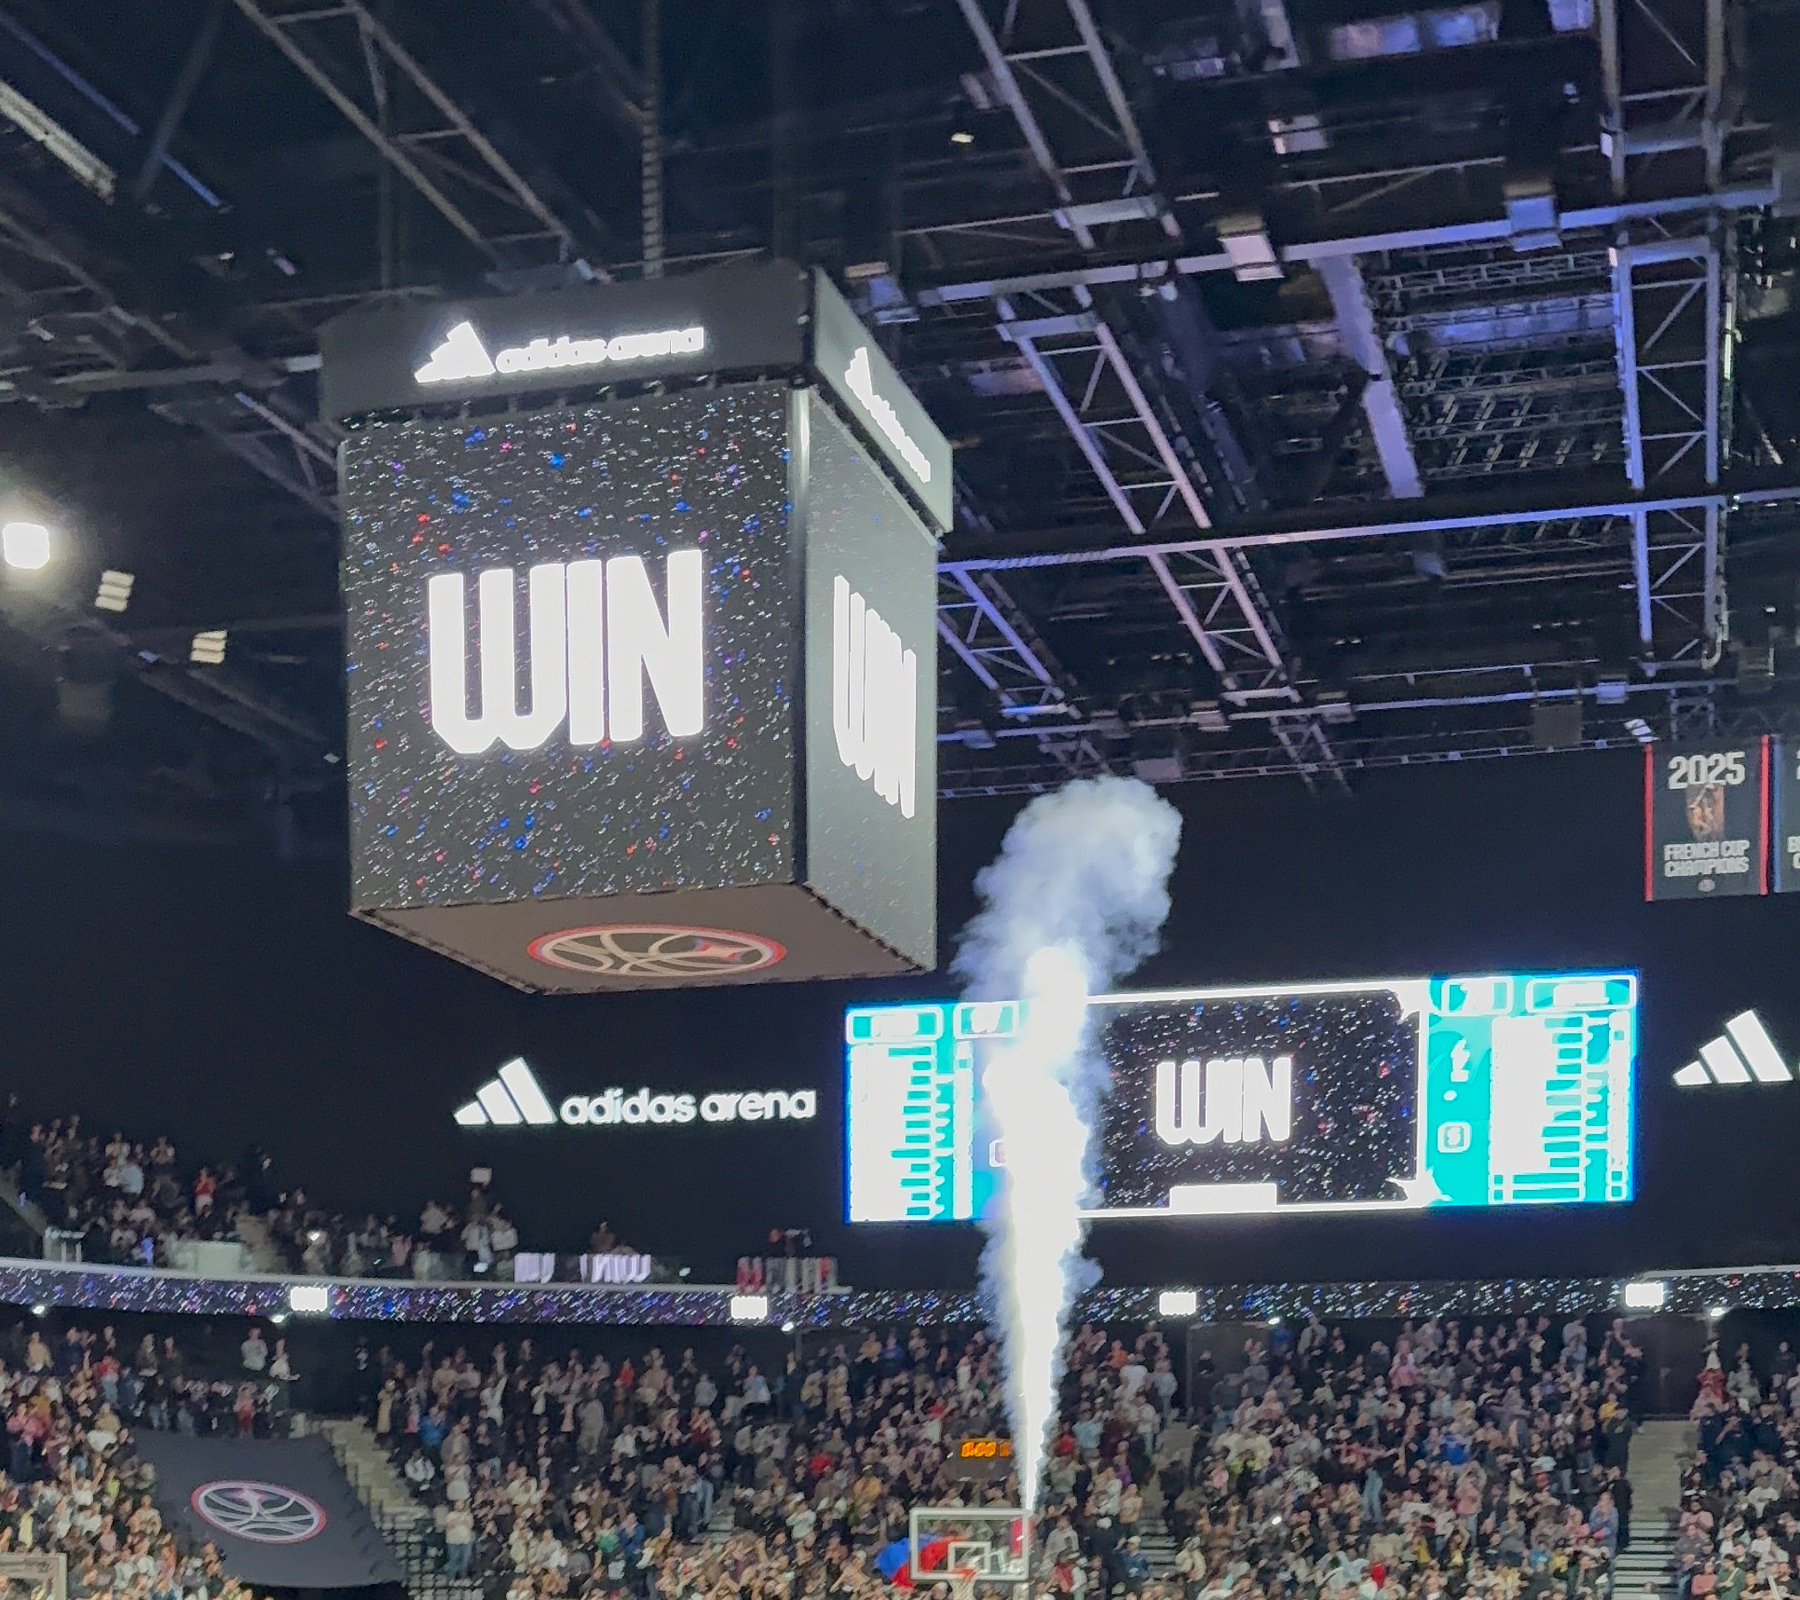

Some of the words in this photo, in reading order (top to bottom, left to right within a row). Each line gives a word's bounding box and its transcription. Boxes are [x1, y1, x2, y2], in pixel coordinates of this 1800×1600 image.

[428, 550, 704, 753] WIN
[1668, 752, 1746, 789] 2025
[1663, 842, 1719, 861] FRENCH
[1720, 840, 1750, 857] CUP
[1664, 856, 1750, 877] CHAMPIONS
[560, 1087, 696, 1125] adidas
[700, 1090, 816, 1122] arena
[1156, 1057, 1291, 1145] WIN
